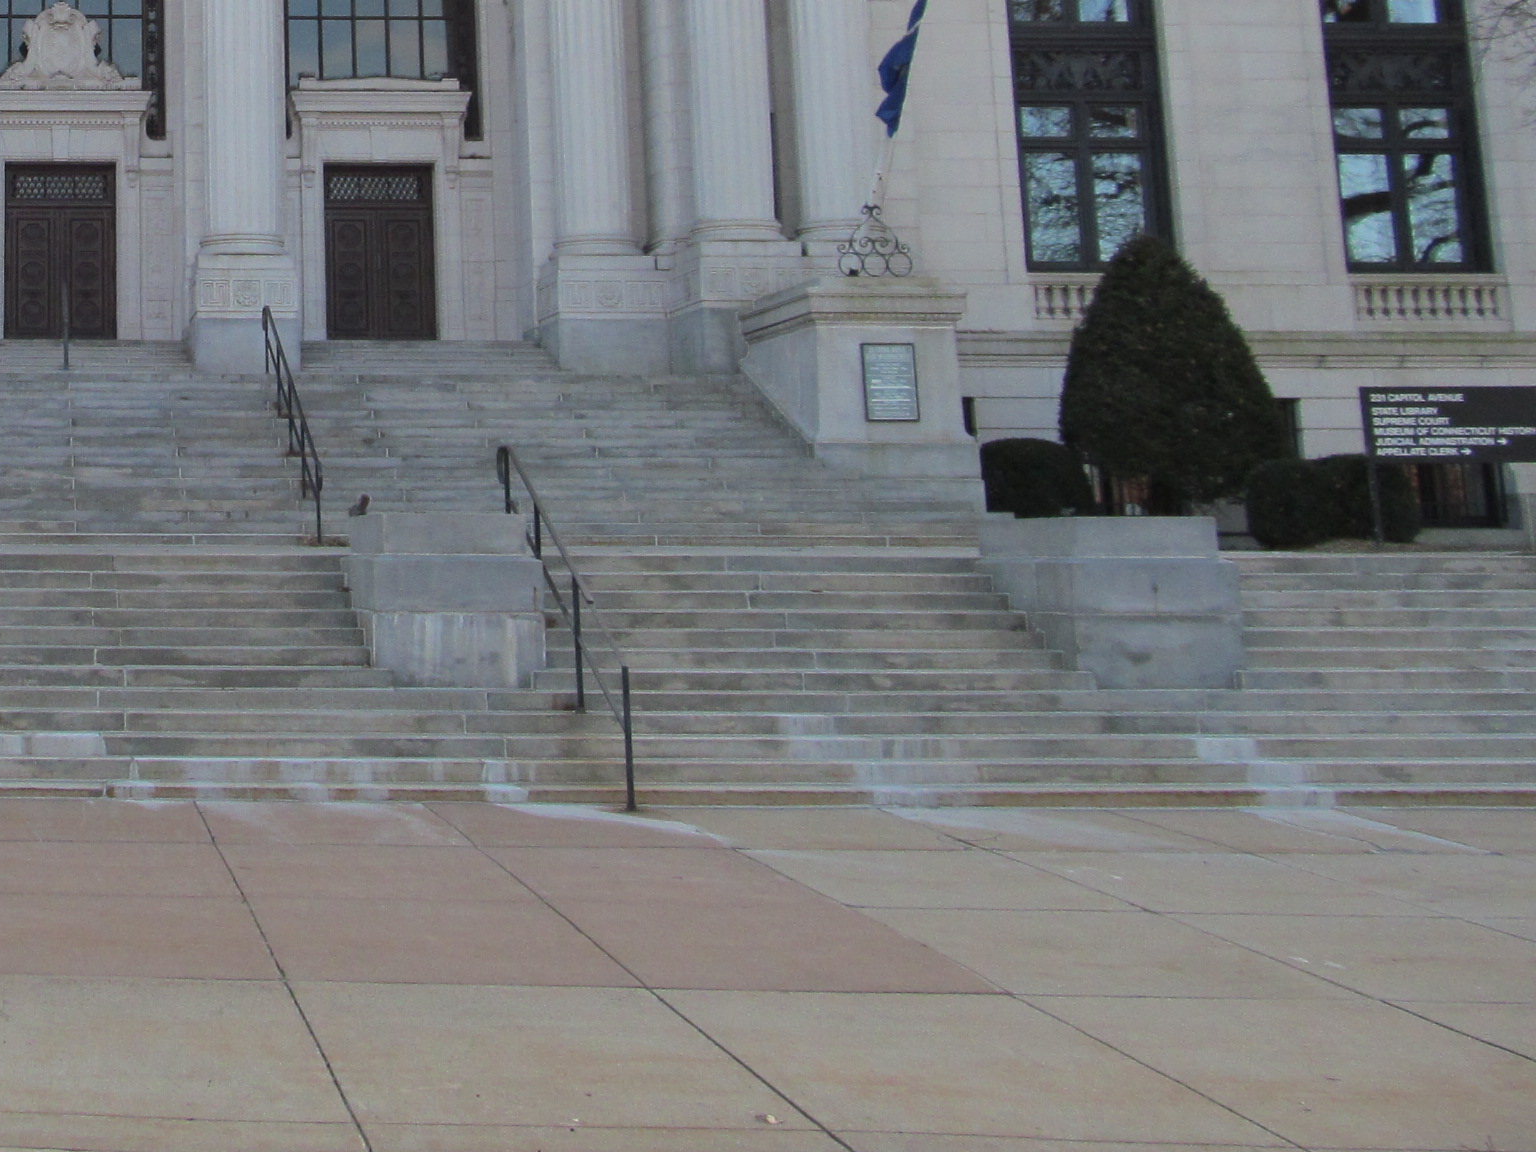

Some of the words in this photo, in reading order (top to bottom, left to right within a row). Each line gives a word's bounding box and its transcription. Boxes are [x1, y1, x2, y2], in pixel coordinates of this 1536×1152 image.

[1389, 393, 1425, 402] CAPITOL
[1428, 393, 1464, 402] AVENUE
[1372, 407, 1398, 415] STATE
[1400, 407, 1438, 415] LIBRARY
[1373, 417, 1416, 426] SUPREME
[1418, 417, 1450, 426] COURT
[1374, 427, 1414, 436] MUSEUM
[1417, 427, 1429, 436] OF
[1431, 427, 1495, 435] CONNECTICUT
[1498, 427, 1536, 435] HISTORY
[1375, 437, 1415, 446] JUDICIAL
[1419, 437, 1495, 446] ADMINISTRATION
[1376, 448, 1426, 456] APPELLATE
[1428, 448, 1459, 456] CLERK
